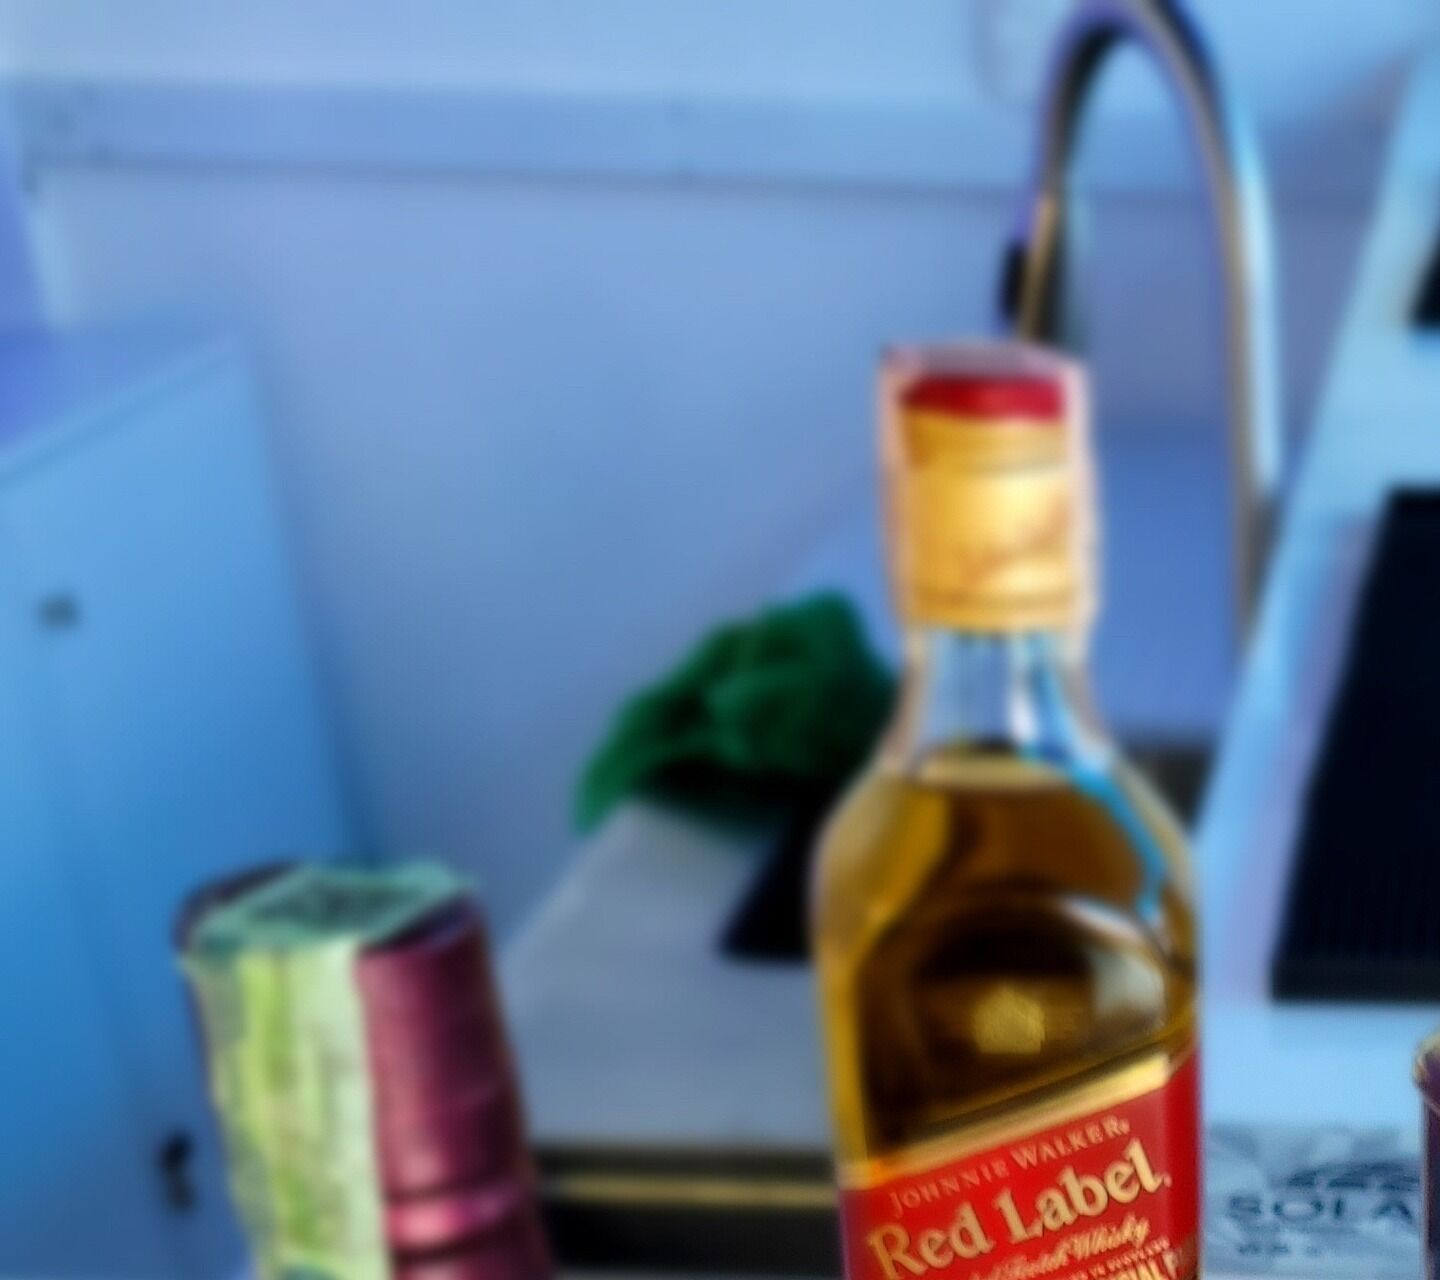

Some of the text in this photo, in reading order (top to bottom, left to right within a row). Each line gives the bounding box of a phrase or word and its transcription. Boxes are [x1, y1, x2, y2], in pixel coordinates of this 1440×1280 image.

[888, 1156, 1010, 1217] JOHNNIE
[994, 1136, 1161, 1243] Label
[1228, 1193, 1415, 1226] SOLA
